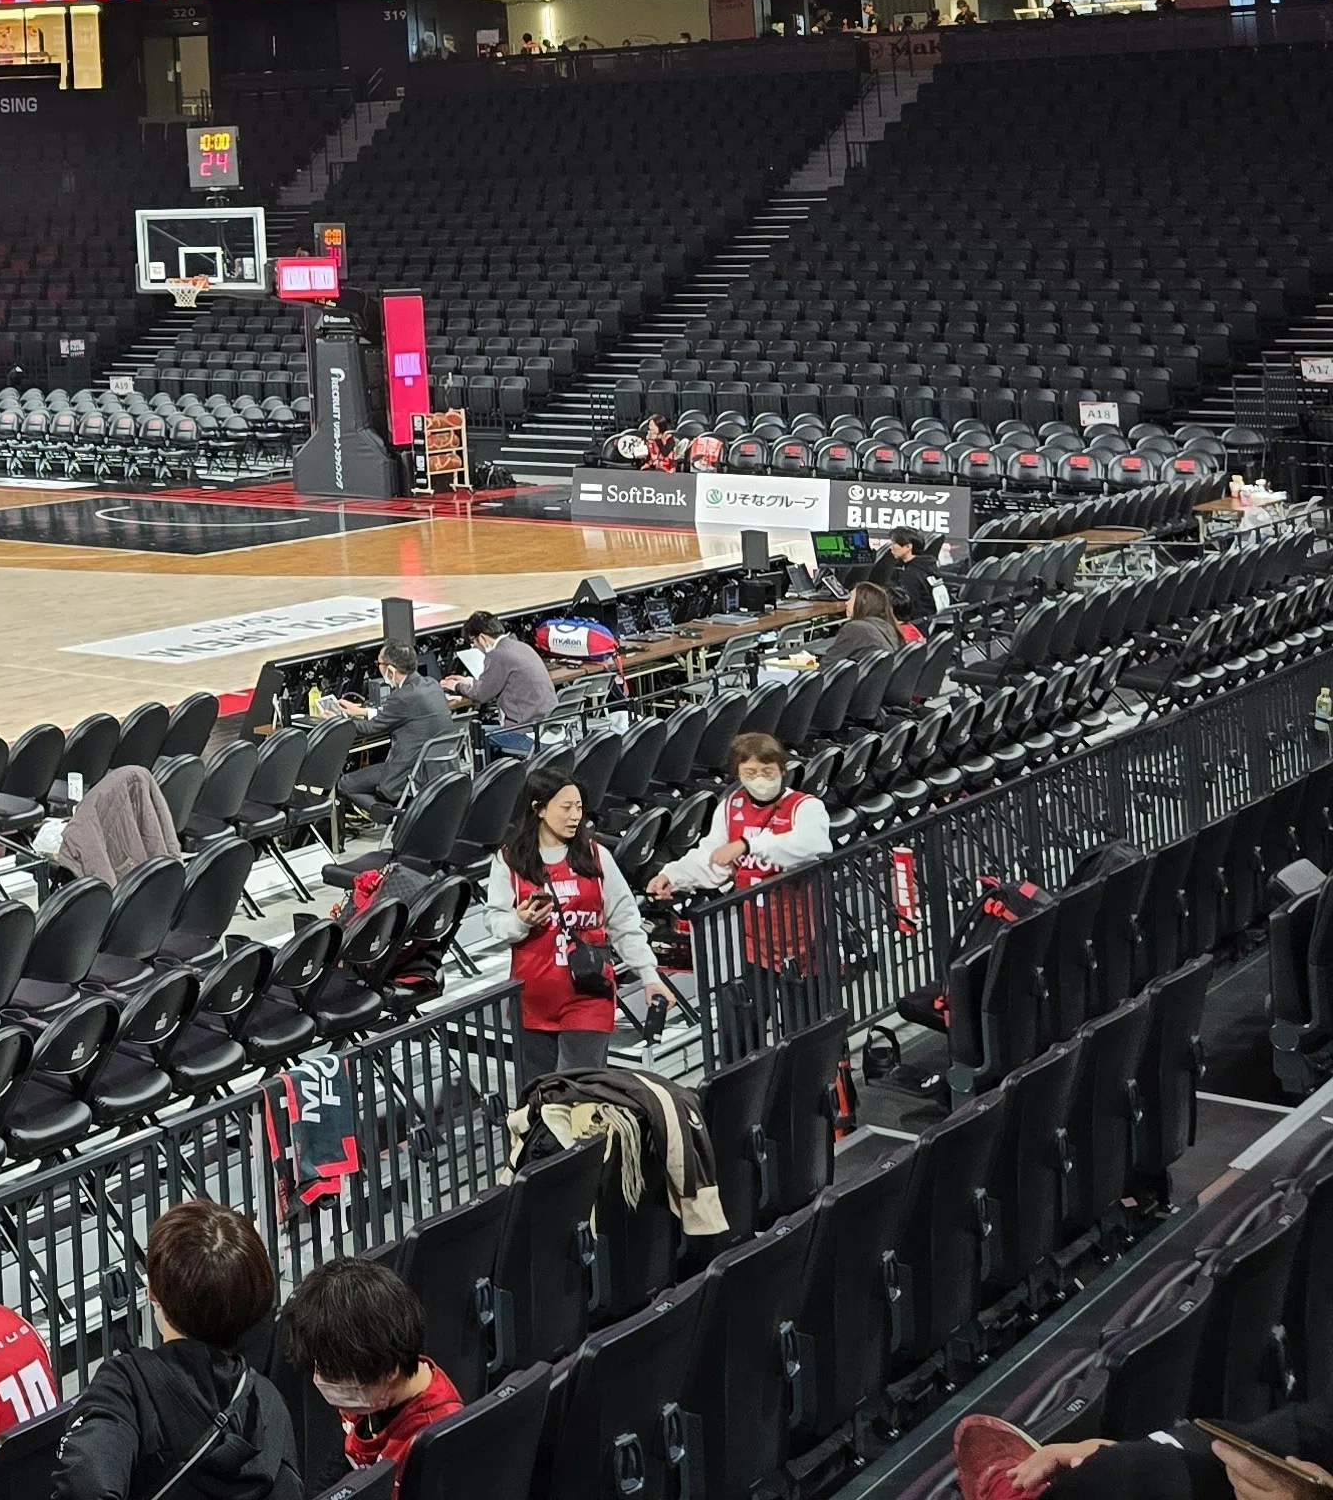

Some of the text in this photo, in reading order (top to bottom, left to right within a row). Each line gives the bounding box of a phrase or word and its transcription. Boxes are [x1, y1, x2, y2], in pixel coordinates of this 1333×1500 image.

[172, 7, 196, 18] 320
[200, 153, 229, 177] 24
[1308, 364, 1330, 376] A17
[1088, 409, 1111, 419] A18
[607, 484, 687, 507] SoftBank
[726, 491, 819, 511] りそなグループ
[866, 486, 950, 506] りそなグループ
[847, 506, 949, 534] B.LEAGUE
